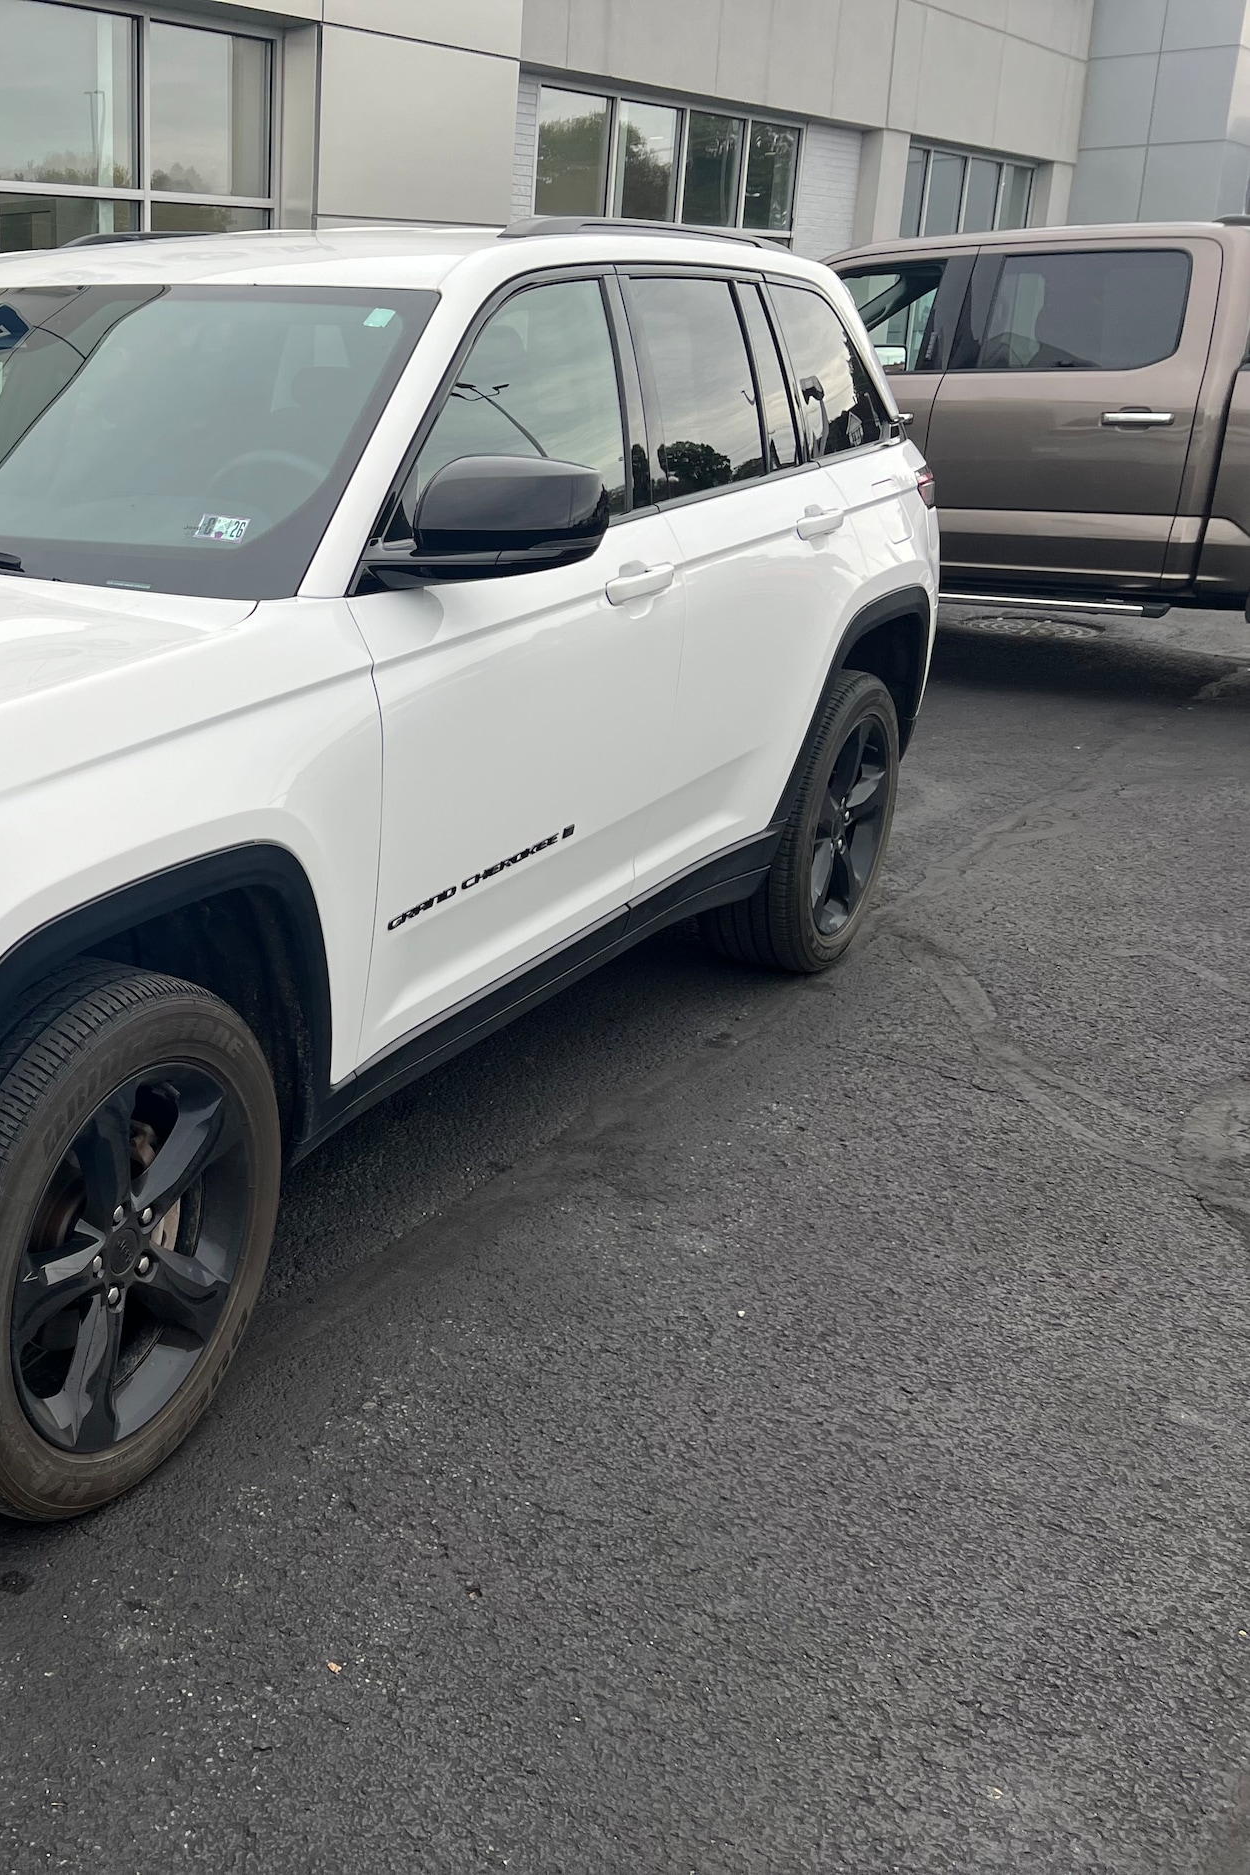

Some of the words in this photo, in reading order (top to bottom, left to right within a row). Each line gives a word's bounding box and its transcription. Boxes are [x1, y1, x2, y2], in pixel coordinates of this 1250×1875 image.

[230, 520, 247, 538] 26
[388, 885, 457, 931] GRAND
[462, 832, 560, 890] CHEROKEE
